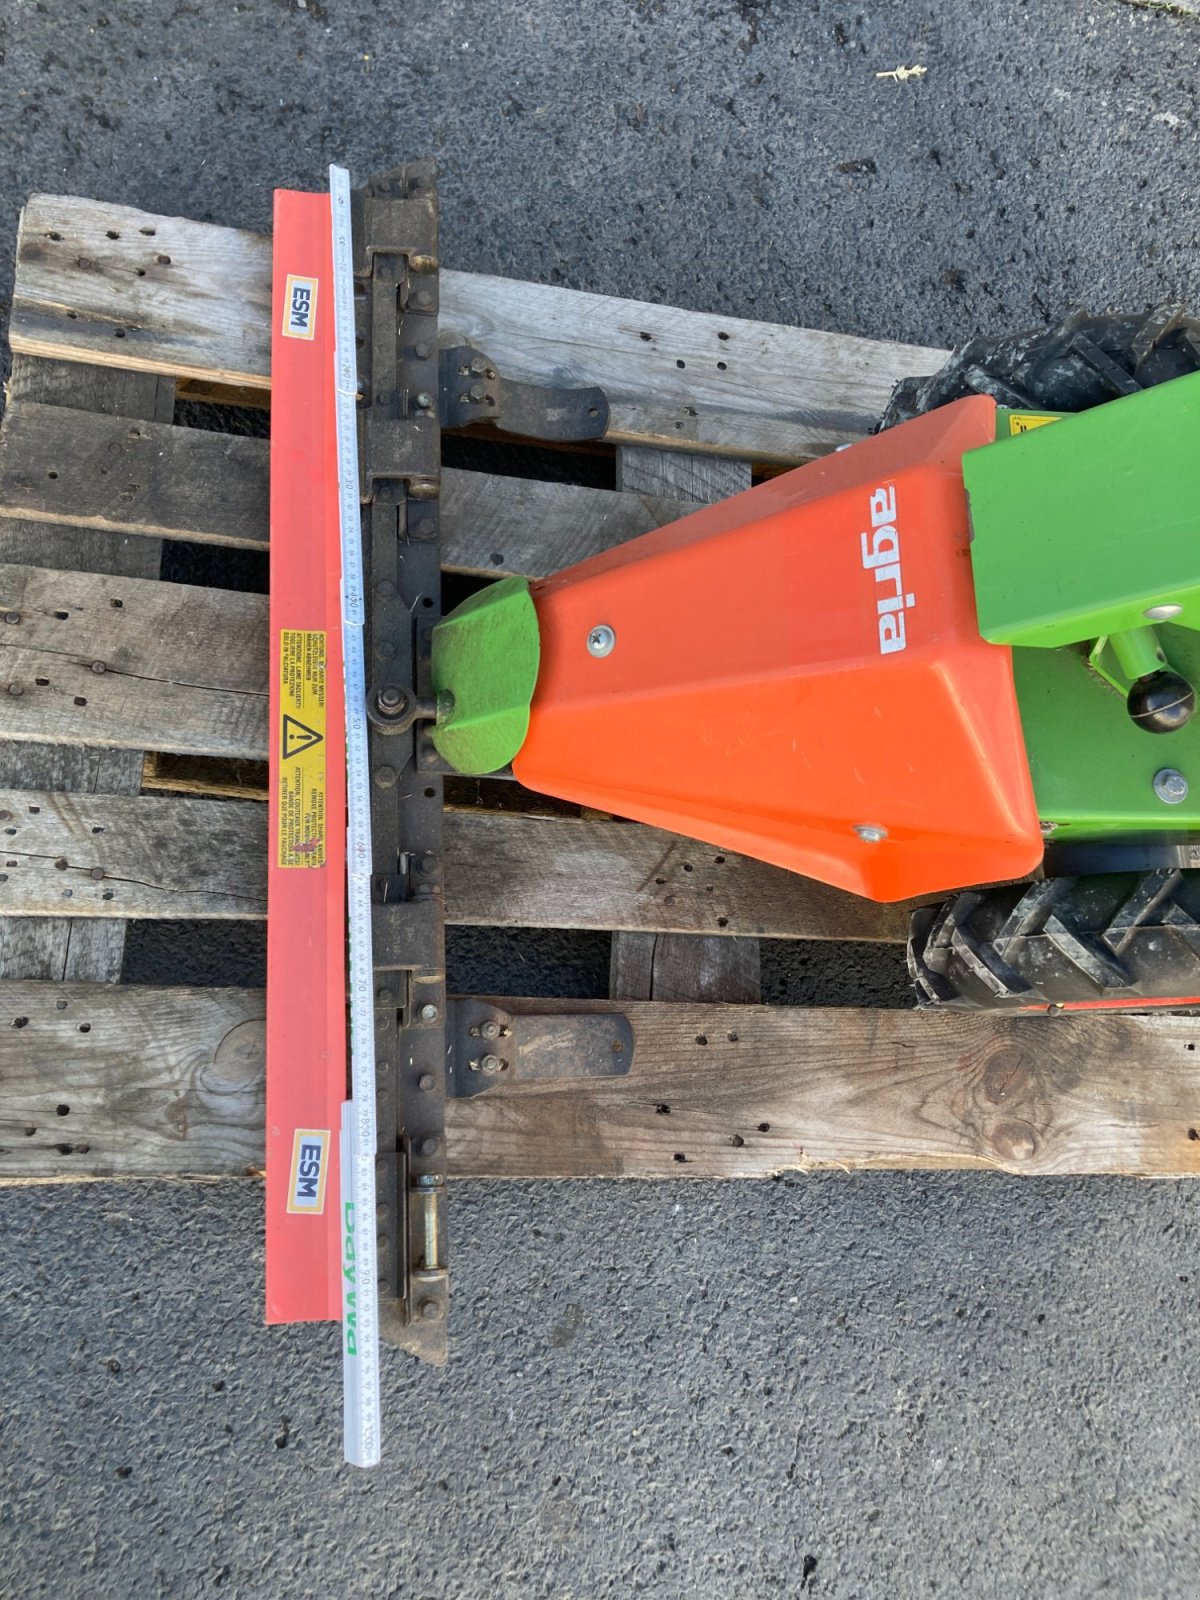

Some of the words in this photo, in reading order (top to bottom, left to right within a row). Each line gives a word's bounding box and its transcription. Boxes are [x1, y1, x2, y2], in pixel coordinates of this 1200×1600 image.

[291, 287, 311, 327] ESM
[860, 484, 916, 655] agria
[352, 717, 361, 729] 50
[358, 979, 367, 992] 70
[297, 1144, 322, 1198] ESM
[361, 1270, 372, 1285] 90
